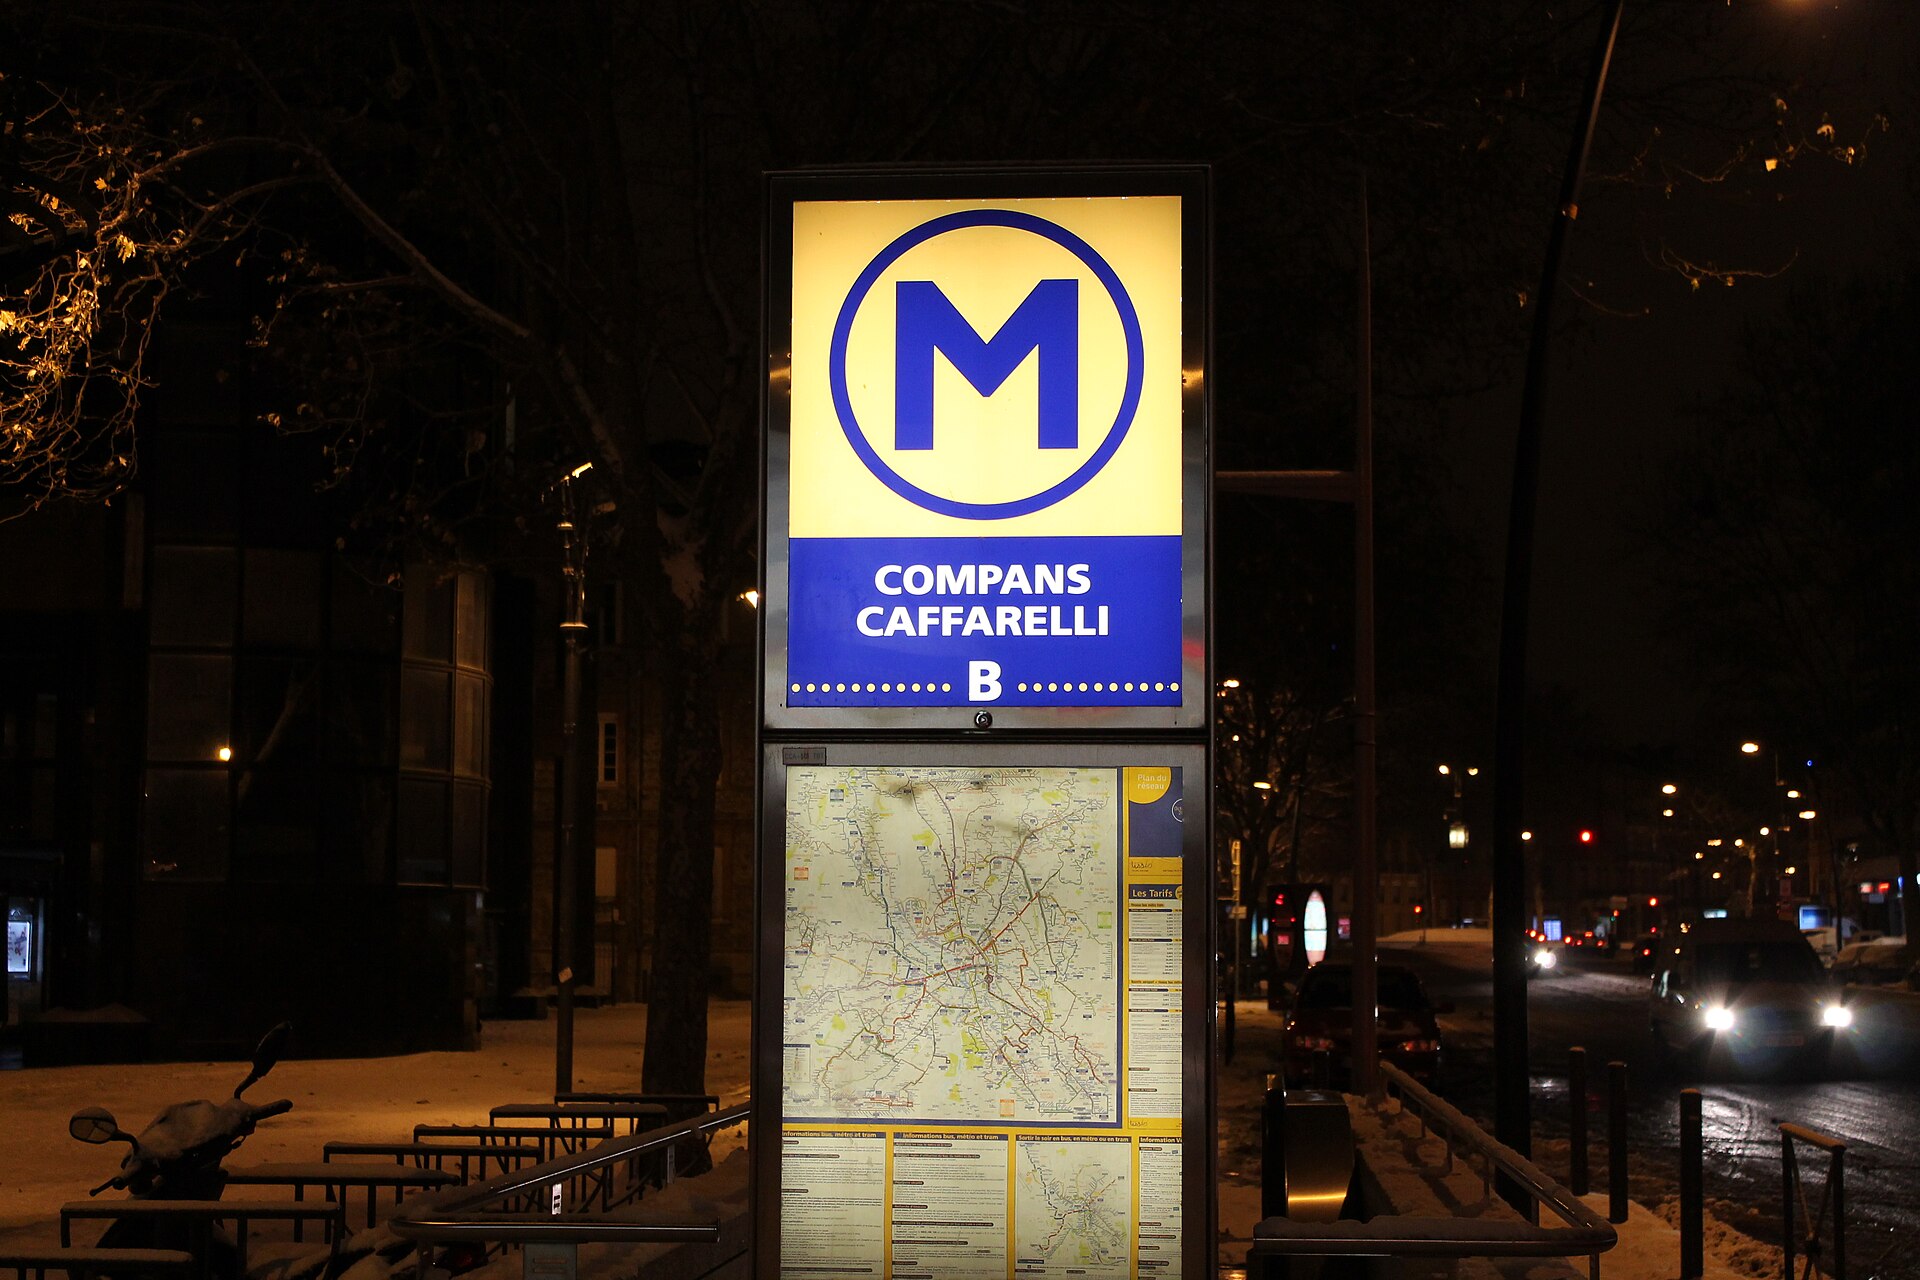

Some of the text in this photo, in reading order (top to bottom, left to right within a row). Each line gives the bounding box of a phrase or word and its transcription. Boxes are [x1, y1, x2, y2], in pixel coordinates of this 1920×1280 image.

[896, 279, 1078, 450] M
[874, 564, 1091, 596] COMPANS
[856, 605, 1109, 637] CAFFARELLI
[968, 660, 1002, 702] B
[1137, 774, 1167, 782] Plan du
[1137, 782, 1164, 790] réseau
[1132, 889, 1173, 898] Les Tarifs
